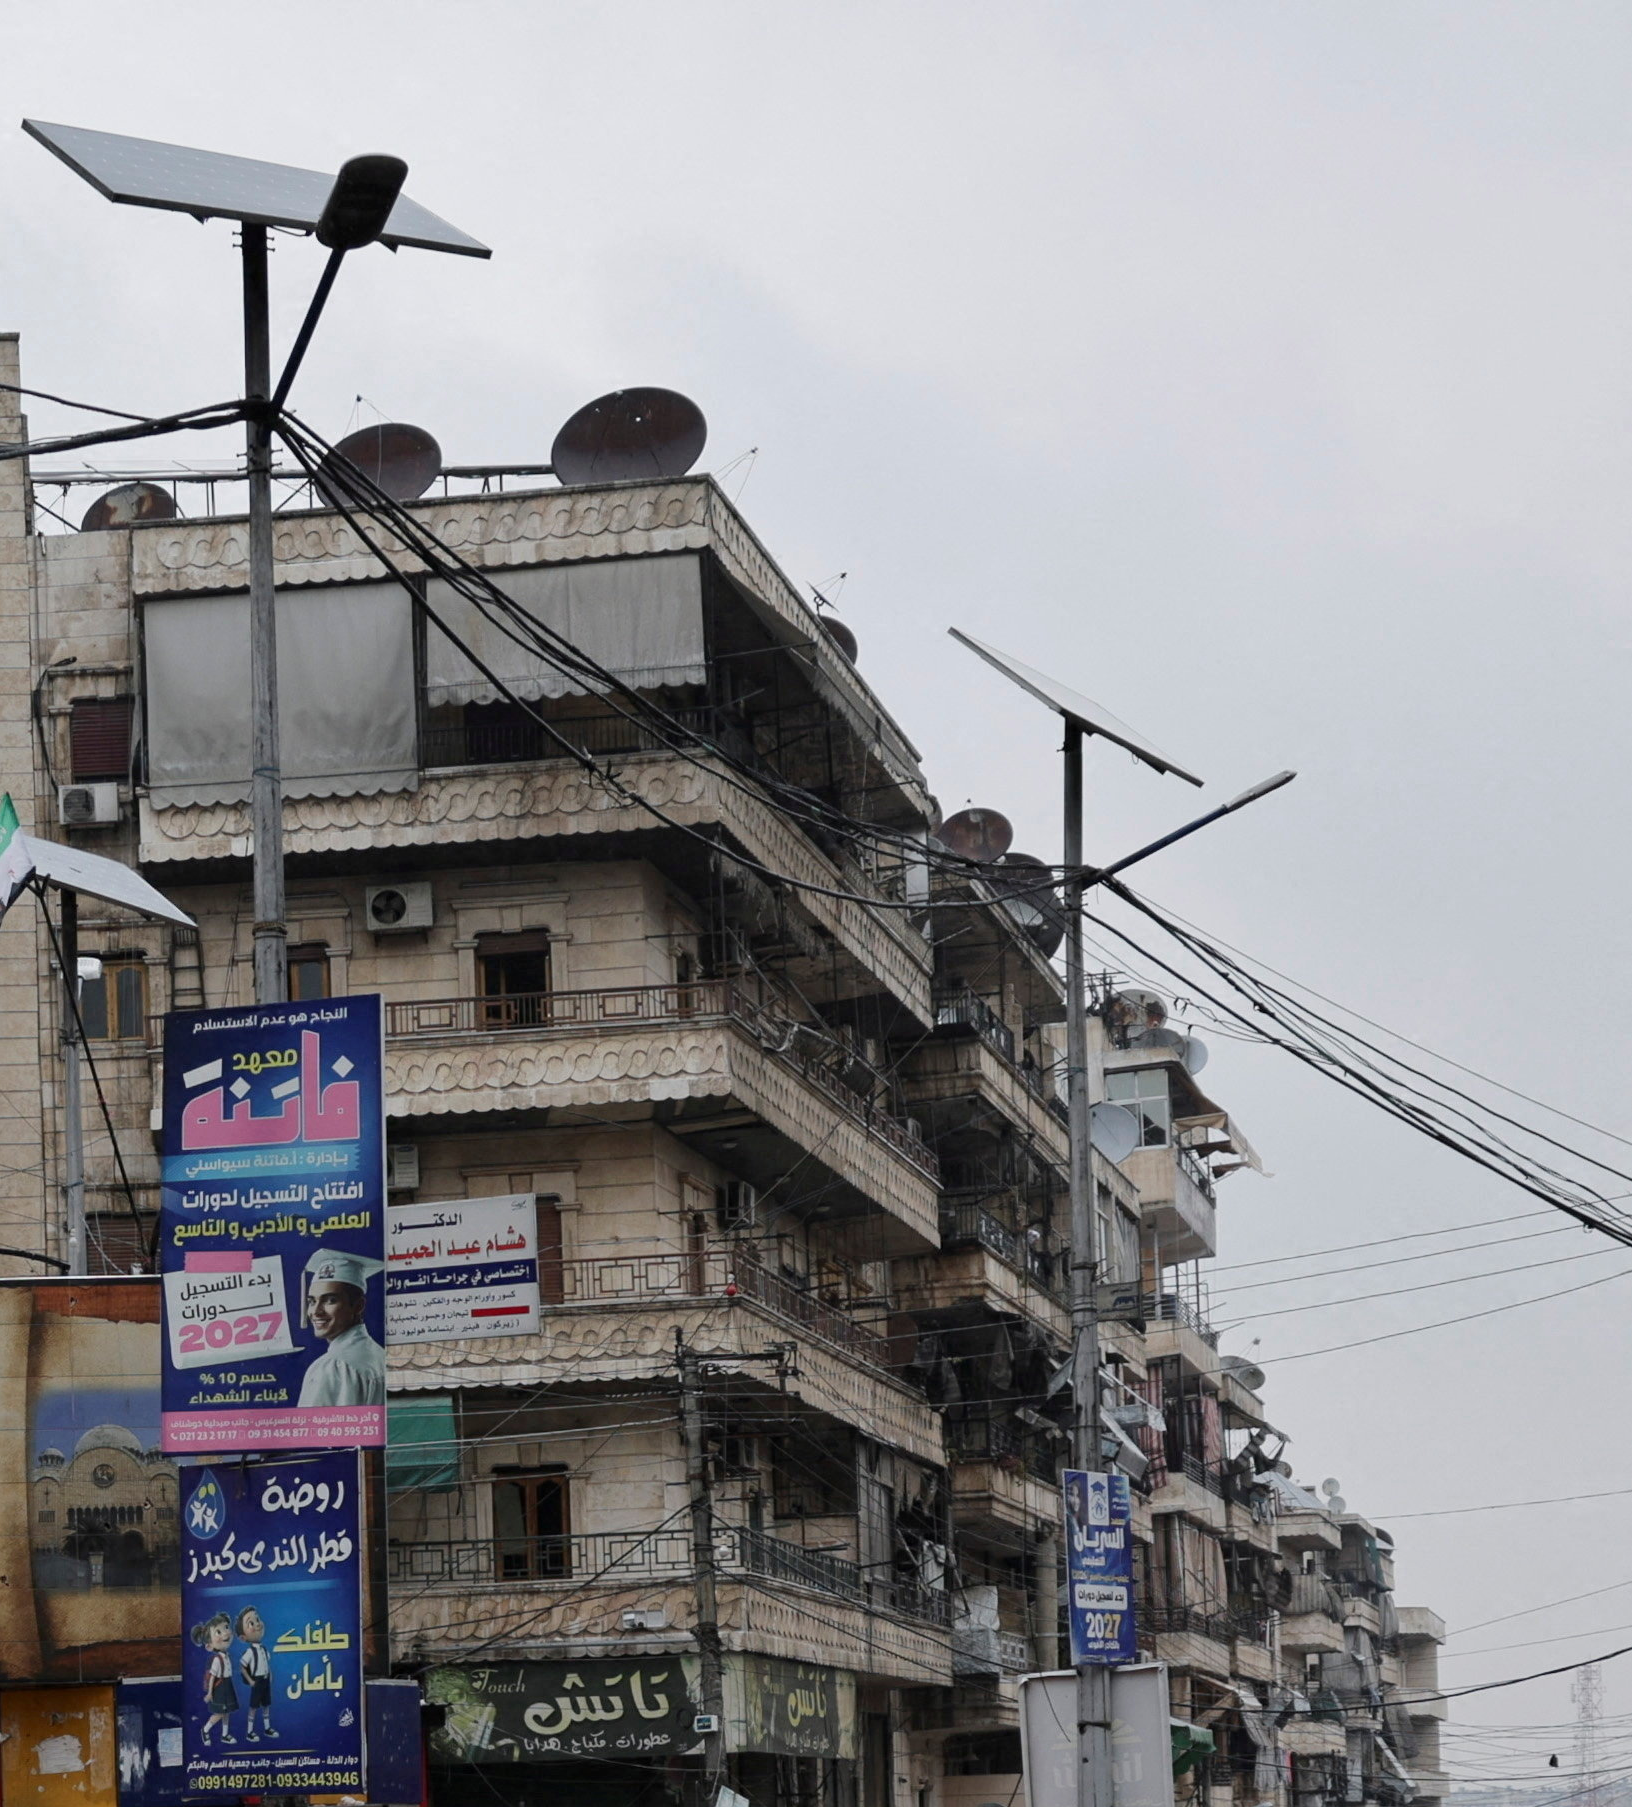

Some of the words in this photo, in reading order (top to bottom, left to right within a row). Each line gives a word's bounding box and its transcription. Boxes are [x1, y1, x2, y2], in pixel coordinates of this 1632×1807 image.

[192, 1015, 258, 1034] الاستسلام
[260, 1015, 286, 1028] عدم
[288, 1014, 307, 1026] هو
[310, 1007, 348, 1025] النجاح
[232, 1048, 298, 1074] معهد
[182, 1029, 360, 1151] فاتنة
[185, 1158, 251, 1178] سيواسلي
[181, 1188, 238, 1212] لدورات
[240, 1184, 308, 1209] التسجيل
[310, 1181, 364, 1210] افتتاح
[173, 1219, 225, 1247] التاسع
[228, 1221, 239, 1240] و
[242, 1212, 293, 1242] الأدبي
[296, 1217, 307, 1236] و
[310, 1210, 370, 1238] العلمي
[391, 1212, 462, 1235] الدكتور
[387, 1238, 442, 1266] الحميد
[446, 1237, 481, 1261] عبد
[485, 1225, 527, 1258] هشام
[180, 1274, 243, 1302] التسجيل
[247, 1272, 272, 1288] بدء
[403, 1273, 431, 1290] الفم
[432, 1271, 469, 1285] جراحة
[470, 1268, 483, 1286] في
[178, 1310, 284, 1354] 2027
[198, 1373, 216, 1385] %
[218, 1371, 237, 1384] 10
[240, 1371, 277, 1387] حسم
[189, 1389, 250, 1405] الشهداء
[179, 1431, 196, 1441] 021
[196, 1430, 208, 1440] 23
[247, 1429, 261, 1439] 09
[262, 1428, 272, 1438] 31
[273, 1428, 291, 1438] 454
[292, 1427, 309, 1438] 877
[317, 1427, 331, 1437] 09
[331, 1426, 344, 1437] 40
[344, 1426, 362, 1437] 595
[362, 1425, 379, 1436] 251
[261, 1476, 345, 1516] روضة
[187, 1530, 236, 1584] كيدز
[307, 1528, 353, 1574] قطر
[272, 1619, 350, 1653] طفلك
[1085, 1611, 1122, 1639] 2027
[286, 1654, 344, 1700] بأمان
[470, 1669, 526, 1693] Touch
[523, 1669, 670, 1736] تاتش
[787, 1664, 827, 1728] تاتش
[523, 1736, 561, 1751] هدايا
[571, 1730, 606, 1754] مكياج
[616, 1731, 672, 1751] عطورات
